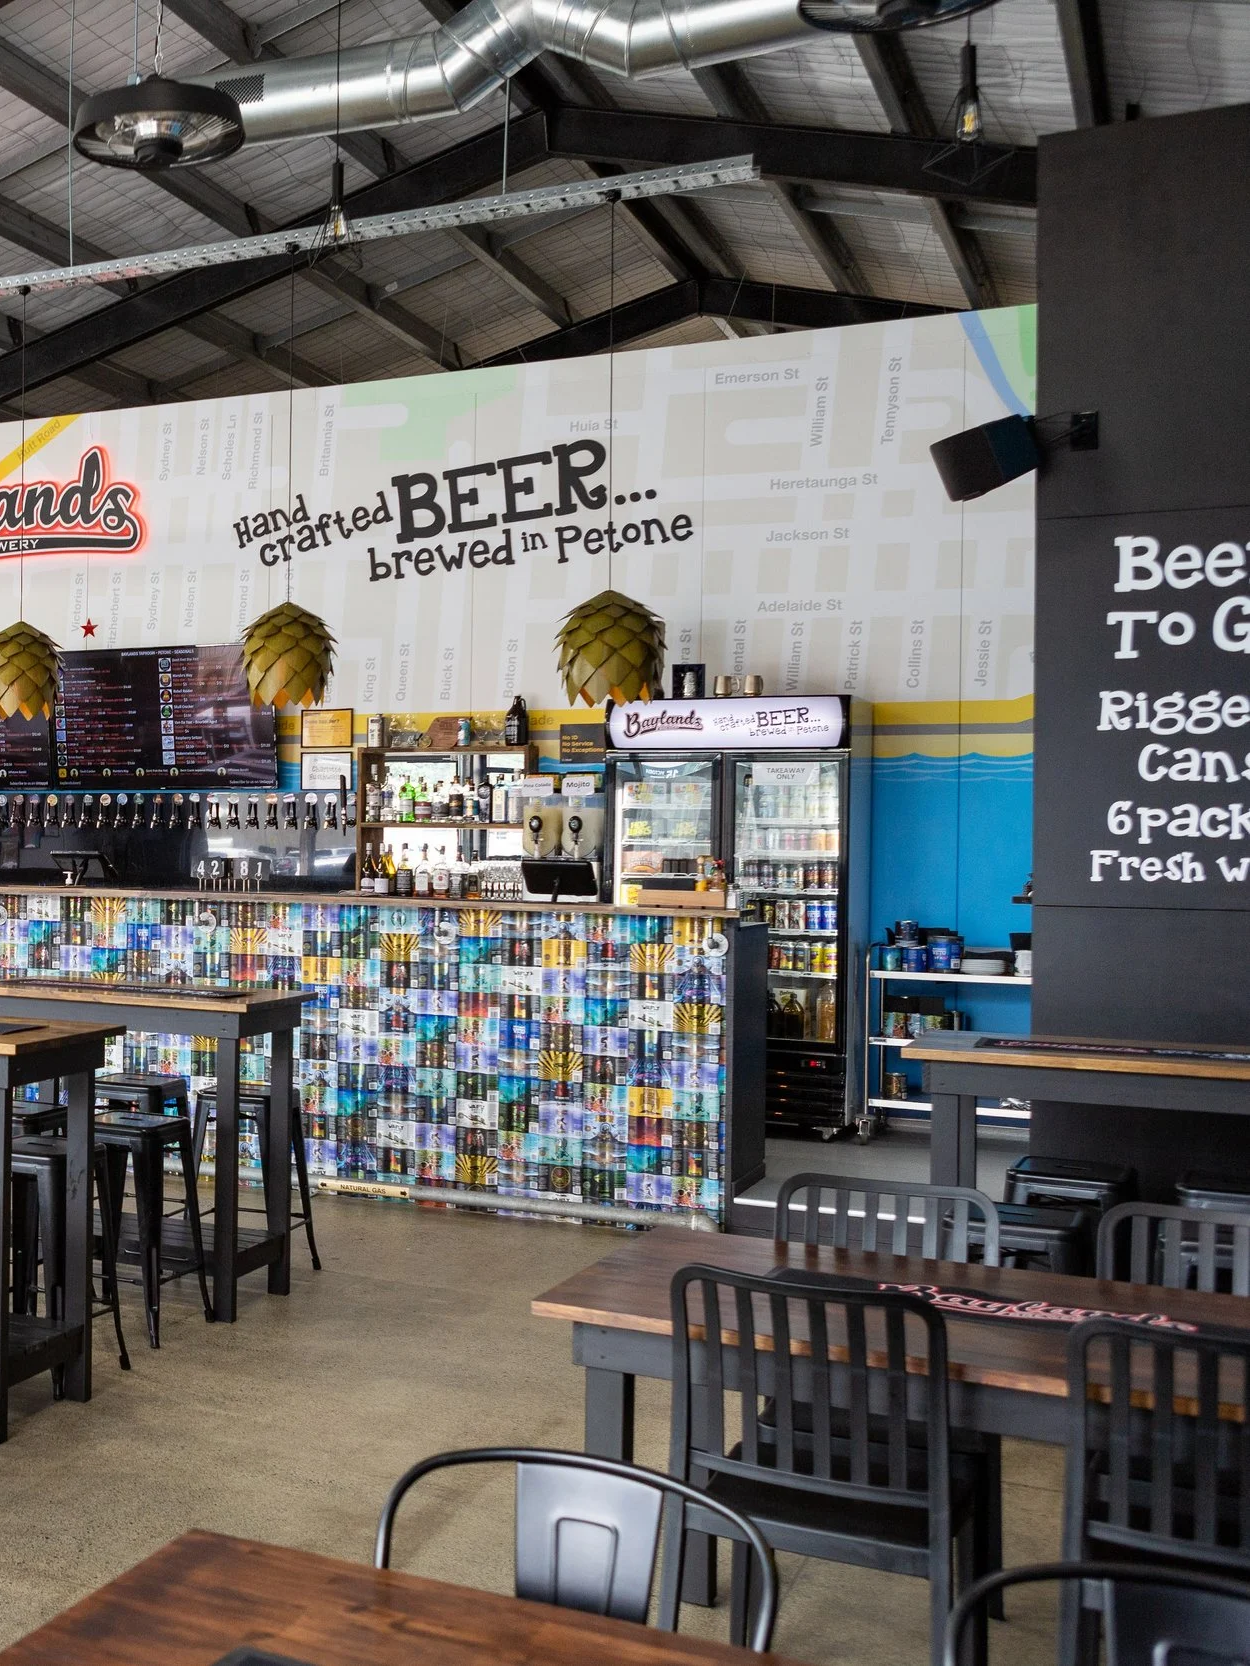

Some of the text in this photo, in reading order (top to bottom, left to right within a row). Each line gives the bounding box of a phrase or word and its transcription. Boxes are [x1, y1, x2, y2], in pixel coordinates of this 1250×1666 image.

[715, 368, 800, 385] Emerson St
[880, 356, 902, 445] Tennyson St
[16, 420, 61, 459] Hutt Road
[320, 403, 334, 476] Britannia St
[569, 417, 618, 433] Huia St
[810, 376, 829, 448] William St
[159, 422, 172, 481] Sydney St
[197, 417, 210, 475] Nelson St
[222, 414, 237, 481] Scholes Ln
[248, 411, 263, 490] Richmond St
[259, 438, 657, 567] crafted BEER...
[770, 473, 878, 491] Heretaunga St
[232, 494, 311, 549] Hand
[368, 512, 693, 582] brewed in Petone
[766, 527, 850, 543] Jackson St
[1113, 535, 1250, 593] Bee
[70, 572, 84, 632] Victoria St
[106, 571, 122, 648] Fitzherbert St
[147, 571, 160, 631] Sydney St
[183, 570, 197, 628] Nelson St
[237, 569, 249, 642] ichmond St
[735, 619, 746, 634] St
[757, 599, 843, 614] Adelaide St
[786, 621, 804, 692] William St
[844, 620, 863, 690] Patrick St
[907, 619, 925, 688] Collins St
[974, 620, 993, 687] Jessie St
[1106, 610, 1196, 660] To
[363, 656, 376, 702] King St
[395, 643, 410, 701] Queen St
[440, 647, 454, 701] Buick St
[503, 638, 518, 699] Bolton St
[623, 709, 704, 739] Baylands
[749, 723, 829, 736] brewed Petone
[566, 781, 591, 789] Mojito
[197, 860, 205, 875] 4
[211, 860, 220, 875] 2
[240, 861, 248, 876] 8
[1090, 849, 1206, 884] Fresh
[340, 1184, 386, 1194] NATURAL GAS
